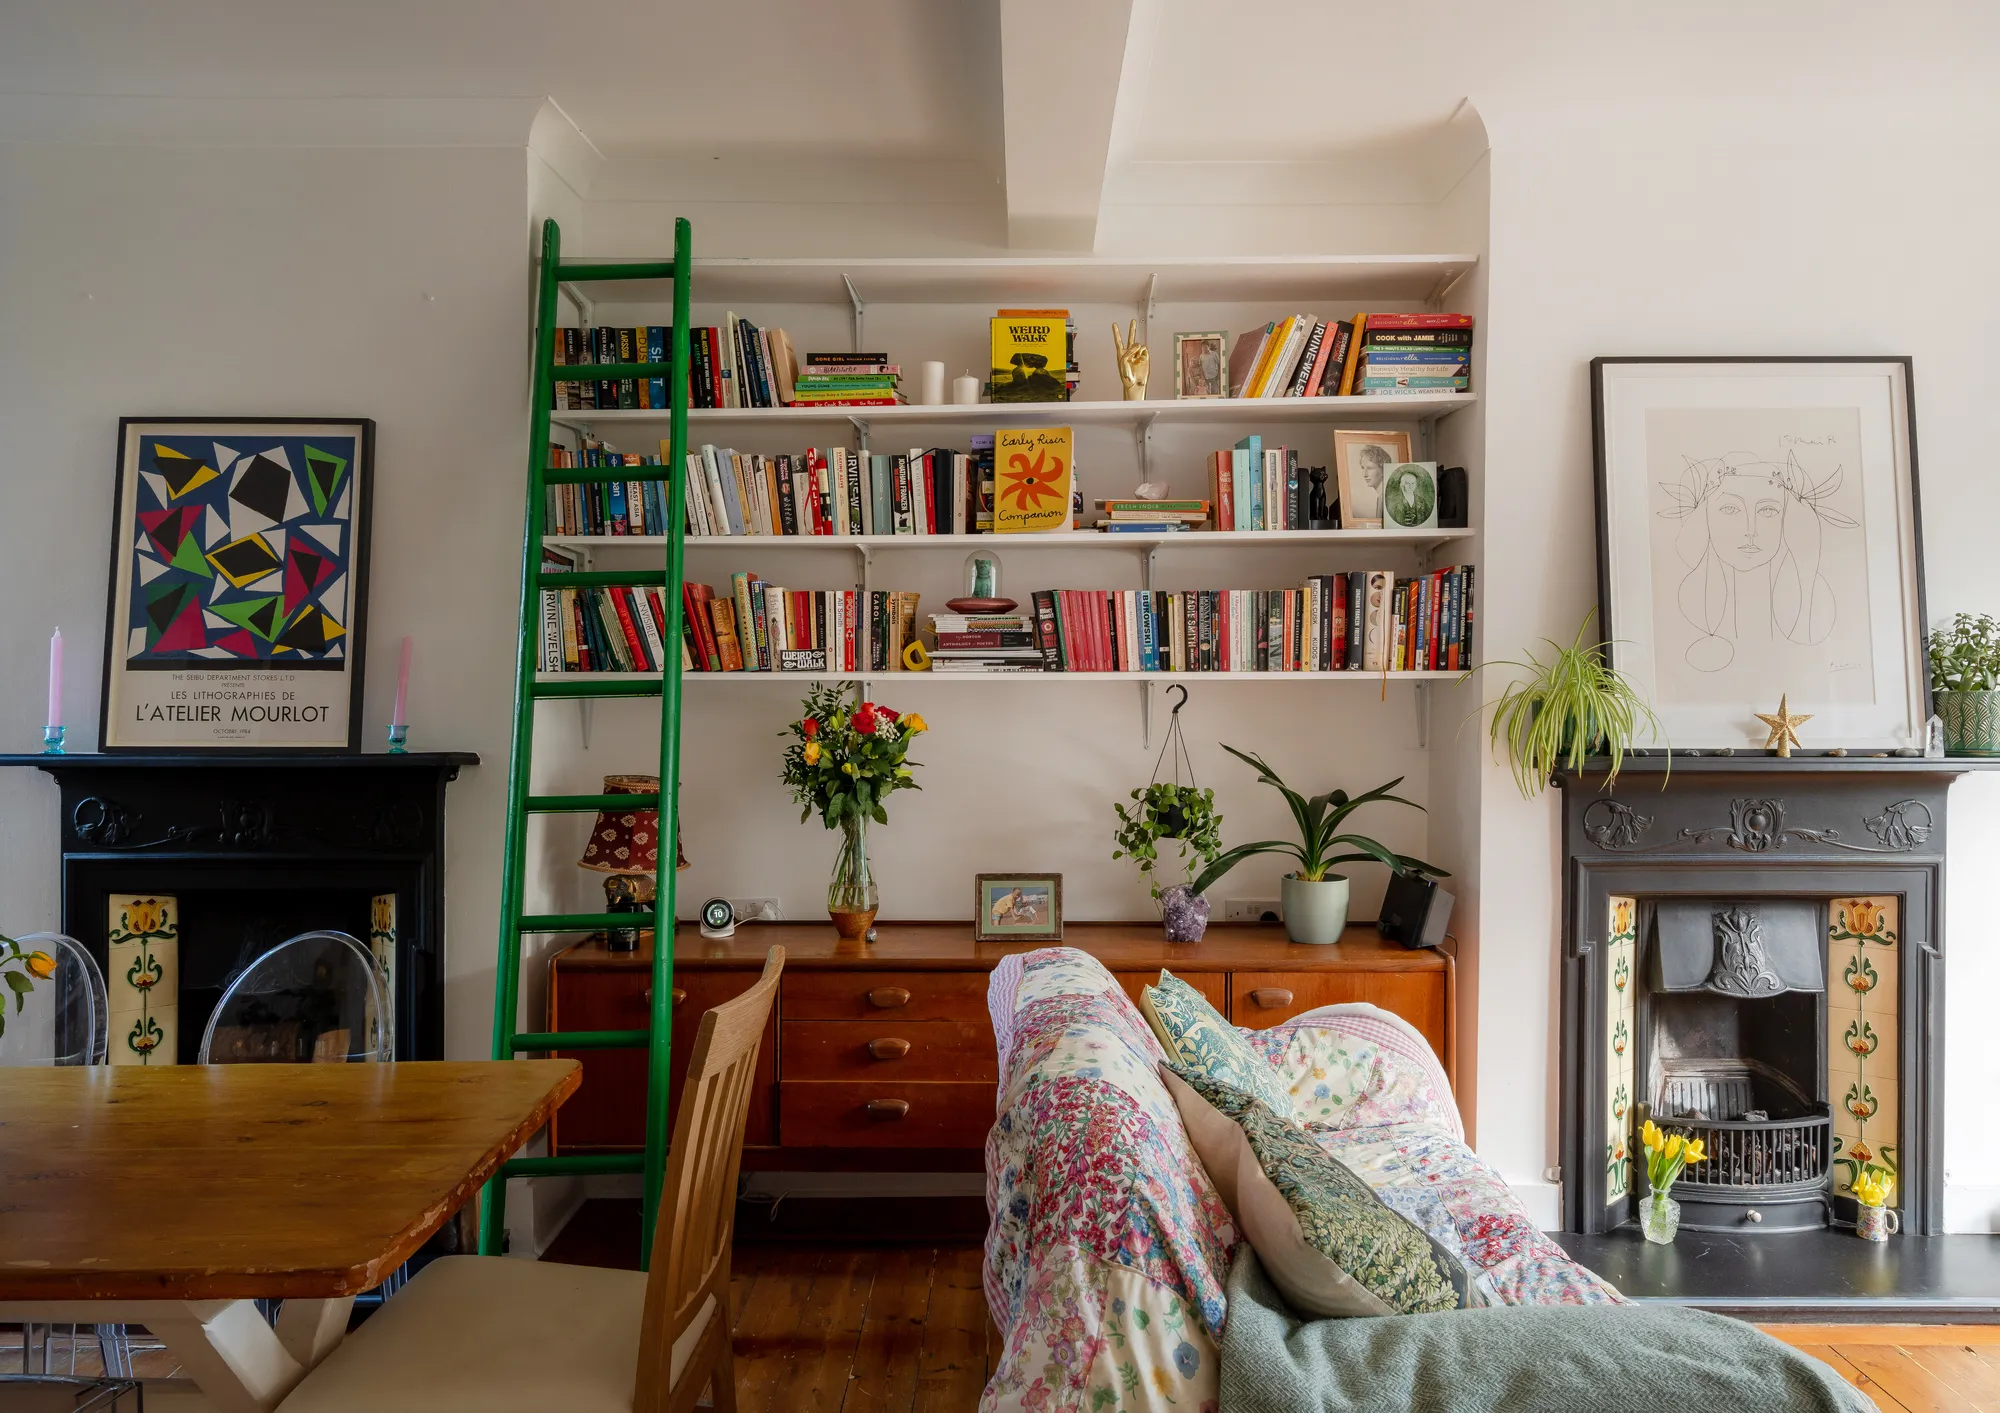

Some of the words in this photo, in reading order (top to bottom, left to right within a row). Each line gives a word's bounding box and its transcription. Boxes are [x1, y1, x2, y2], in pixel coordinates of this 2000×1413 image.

[1008, 326, 1050, 334] WEIRD
[1012, 334, 1048, 342] WALK
[1306, 323, 1326, 361] IRVINE
[620, 331, 629, 359] LARSSON
[753, 333, 761, 355] PIGEON
[757, 355, 766, 381] ENGLISH
[1293, 362, 1312, 397] WELSH
[1001, 433, 1034, 452] Early
[1037, 434, 1065, 444] Riser
[808, 451, 818, 507] ANIMALS
[848, 455, 859, 494] IRVINE
[898, 458, 906, 485] JONATHAN
[900, 486, 908, 511] FRANZEN
[850, 495, 860, 535] WSH
[998, 509, 1063, 526] Companion
[546, 590, 557, 628] IRVINE
[639, 602, 656, 638] INVISIBLE
[714, 602, 725, 632] MARTIN
[1142, 595, 1151, 644] BUKOWSKI
[1187, 594, 1196, 619] ZADIE
[1187, 620, 1197, 647] SMITH
[548, 632, 559, 672] WELSH
[782, 651, 813, 660] WEIRD
[797, 658, 825, 668] WALK
[171, 691, 187, 700] LES
[194, 691, 275, 700] LITHOGRAPHIES
[282, 692, 295, 700] DE
[136, 703, 221, 722] L'ATELIER
[231, 706, 329, 722] MOURLOT
[714, 910, 723, 918] 10
